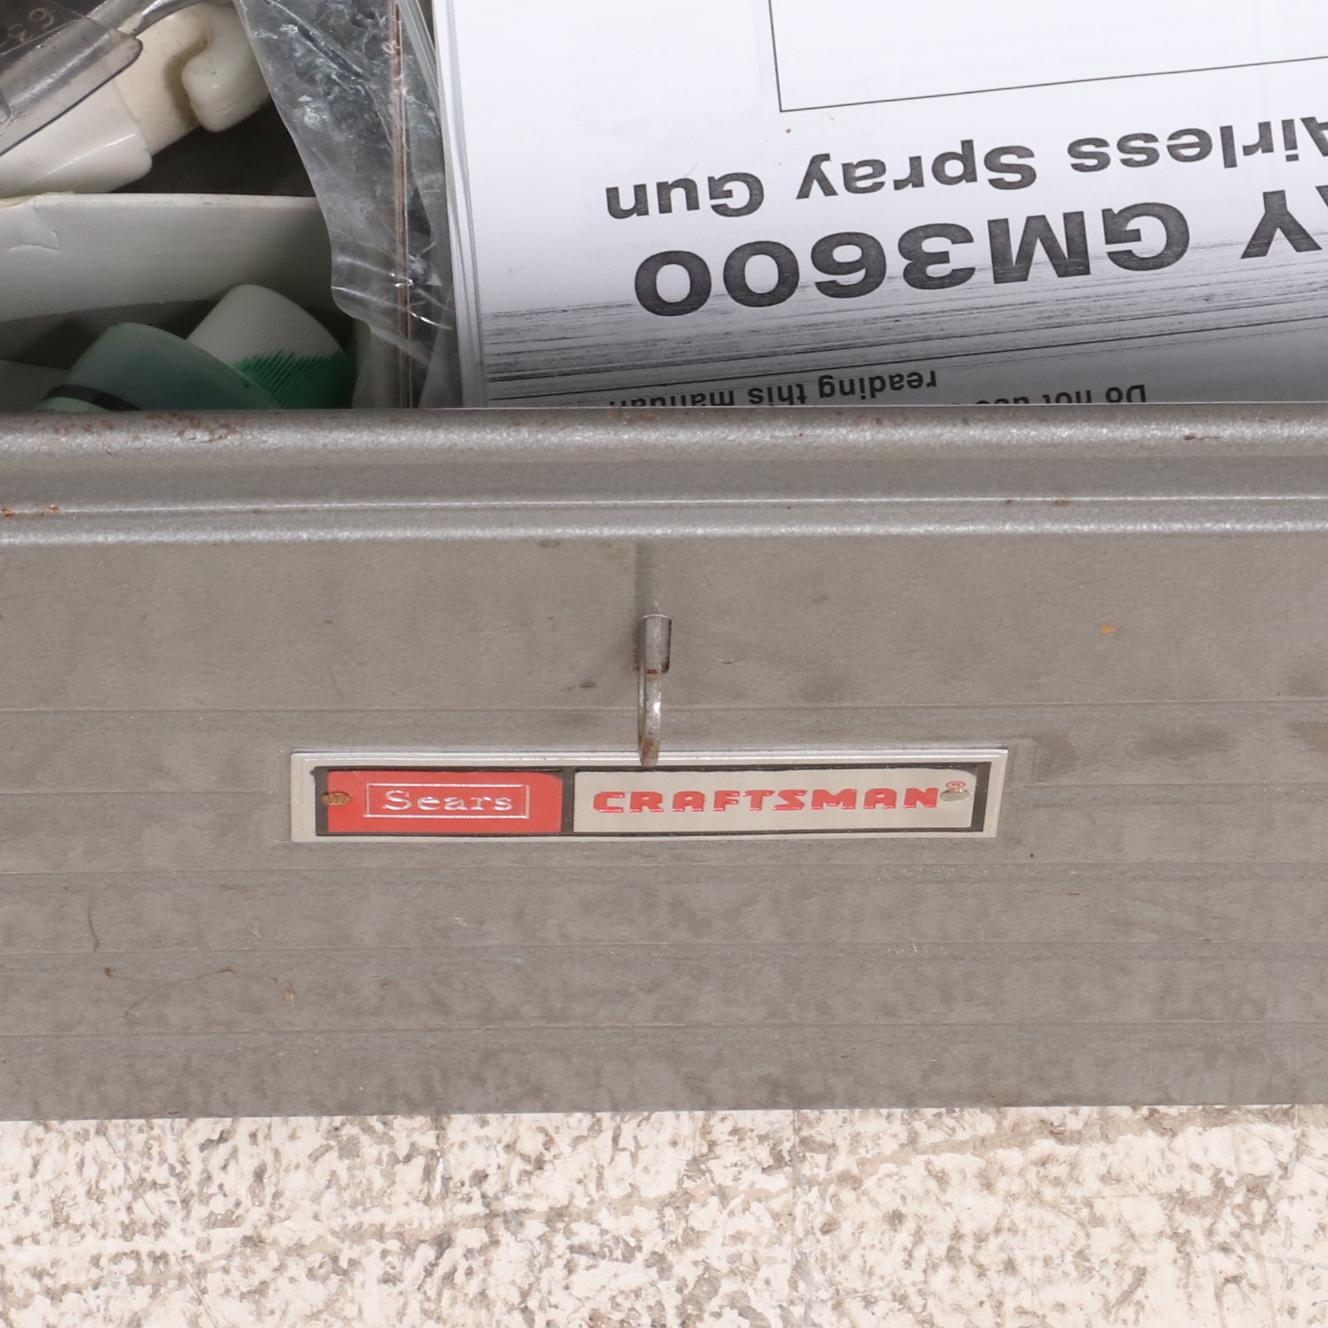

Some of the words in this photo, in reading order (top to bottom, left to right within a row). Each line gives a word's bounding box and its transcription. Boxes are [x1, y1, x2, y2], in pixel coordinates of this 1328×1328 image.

[796, 139, 1038, 199] Spray
[605, 171, 765, 220] Gun
[633, 201, 1191, 317] GM3600
[749, 382, 806, 406] this
[818, 369, 938, 403] reading
[382, 787, 514, 813] Sears
[592, 786, 939, 814] CRAFTSMAN
